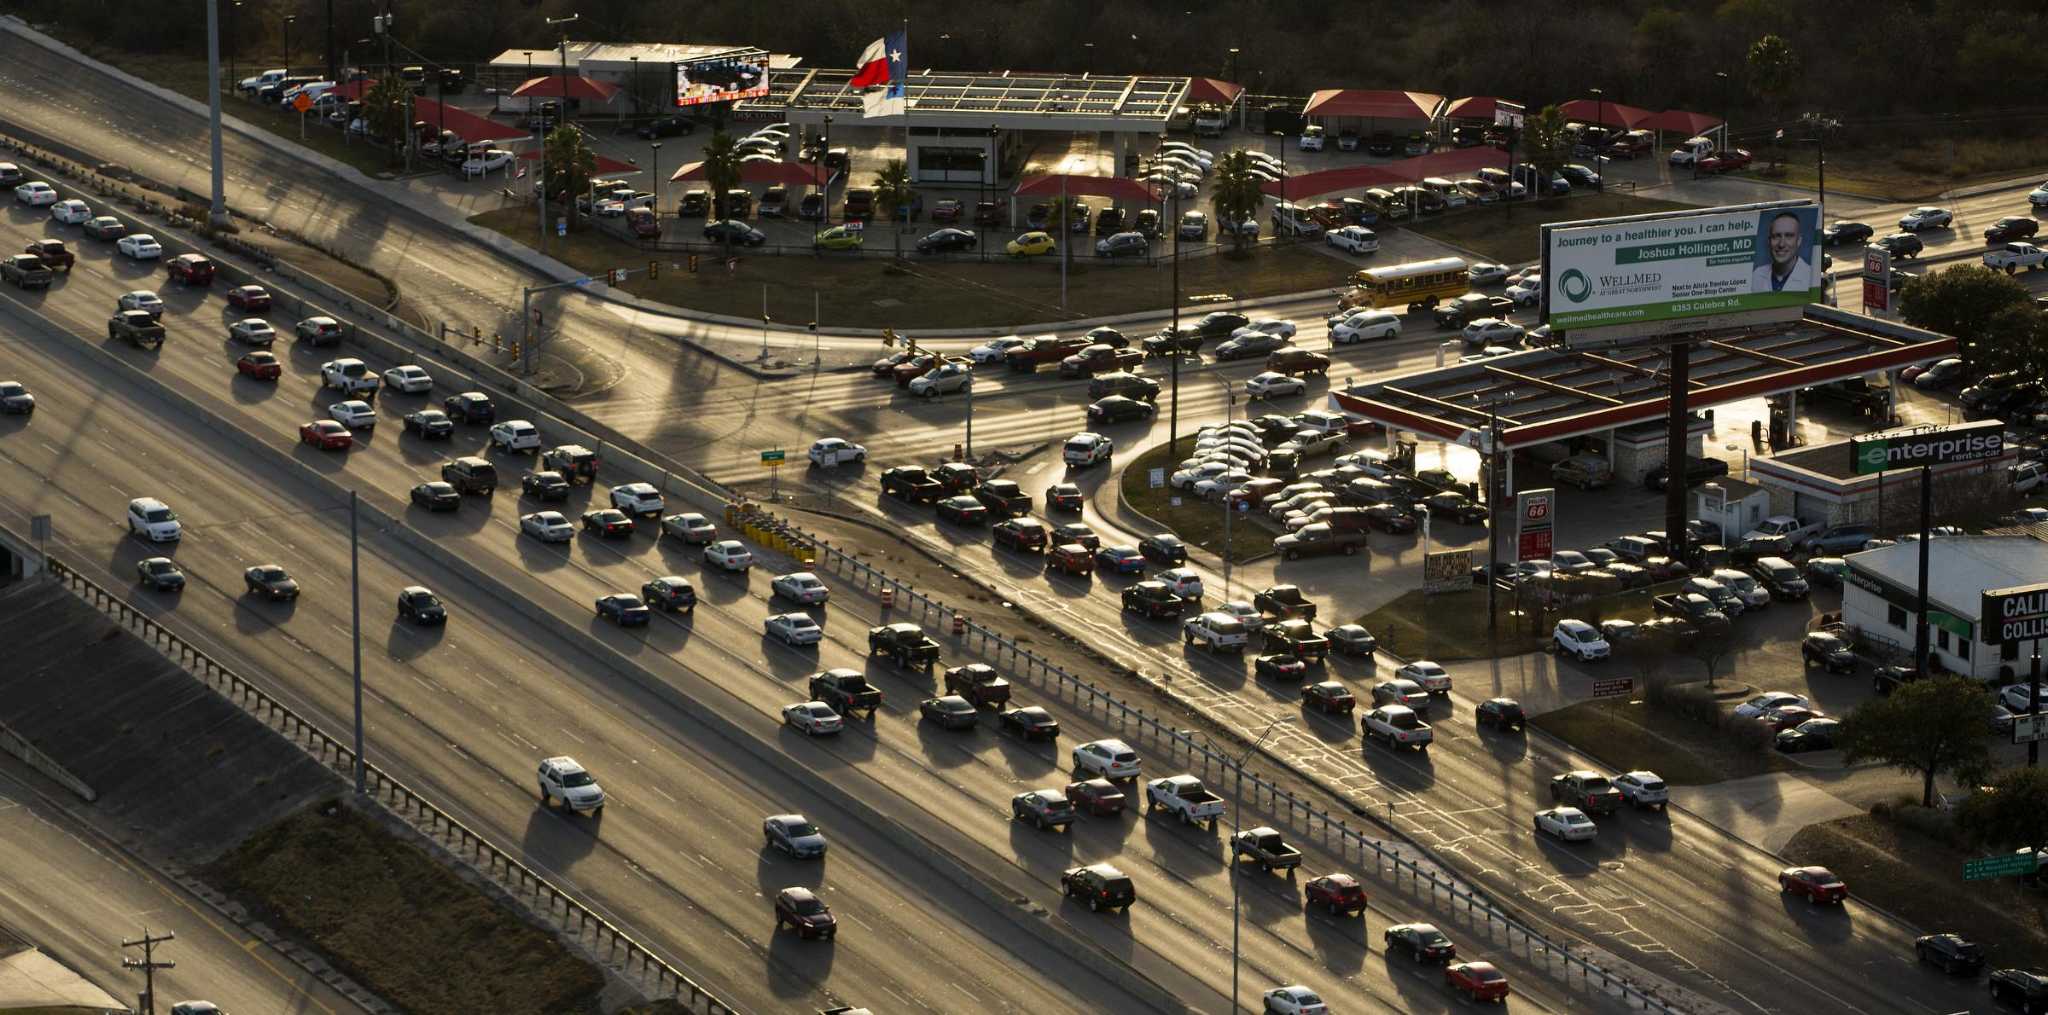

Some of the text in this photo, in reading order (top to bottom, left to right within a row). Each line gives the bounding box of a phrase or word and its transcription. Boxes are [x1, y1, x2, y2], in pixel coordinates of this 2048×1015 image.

[1558, 235, 1598, 247] Journey
[1601, 234, 1612, 243] to
[1625, 228, 1674, 241] healthier
[1674, 227, 1696, 238] you.
[1700, 224, 1703, 234] I
[1706, 224, 1725, 233] can
[1728, 220, 1753, 231] help.
[1638, 239, 1752, 259] Joshua Hollinger, MD
[1600, 273, 1662, 287] WELLMED
[1693, 301, 1725, 310] Culebra
[1556, 310, 1645, 323] wellmedhealthcare.com
[1860, 433, 2001, 464] enterprise
[1951, 450, 2000, 461] rent-a-car
[1529, 505, 1545, 517] 66
[1849, 573, 1882, 594] nterprise
